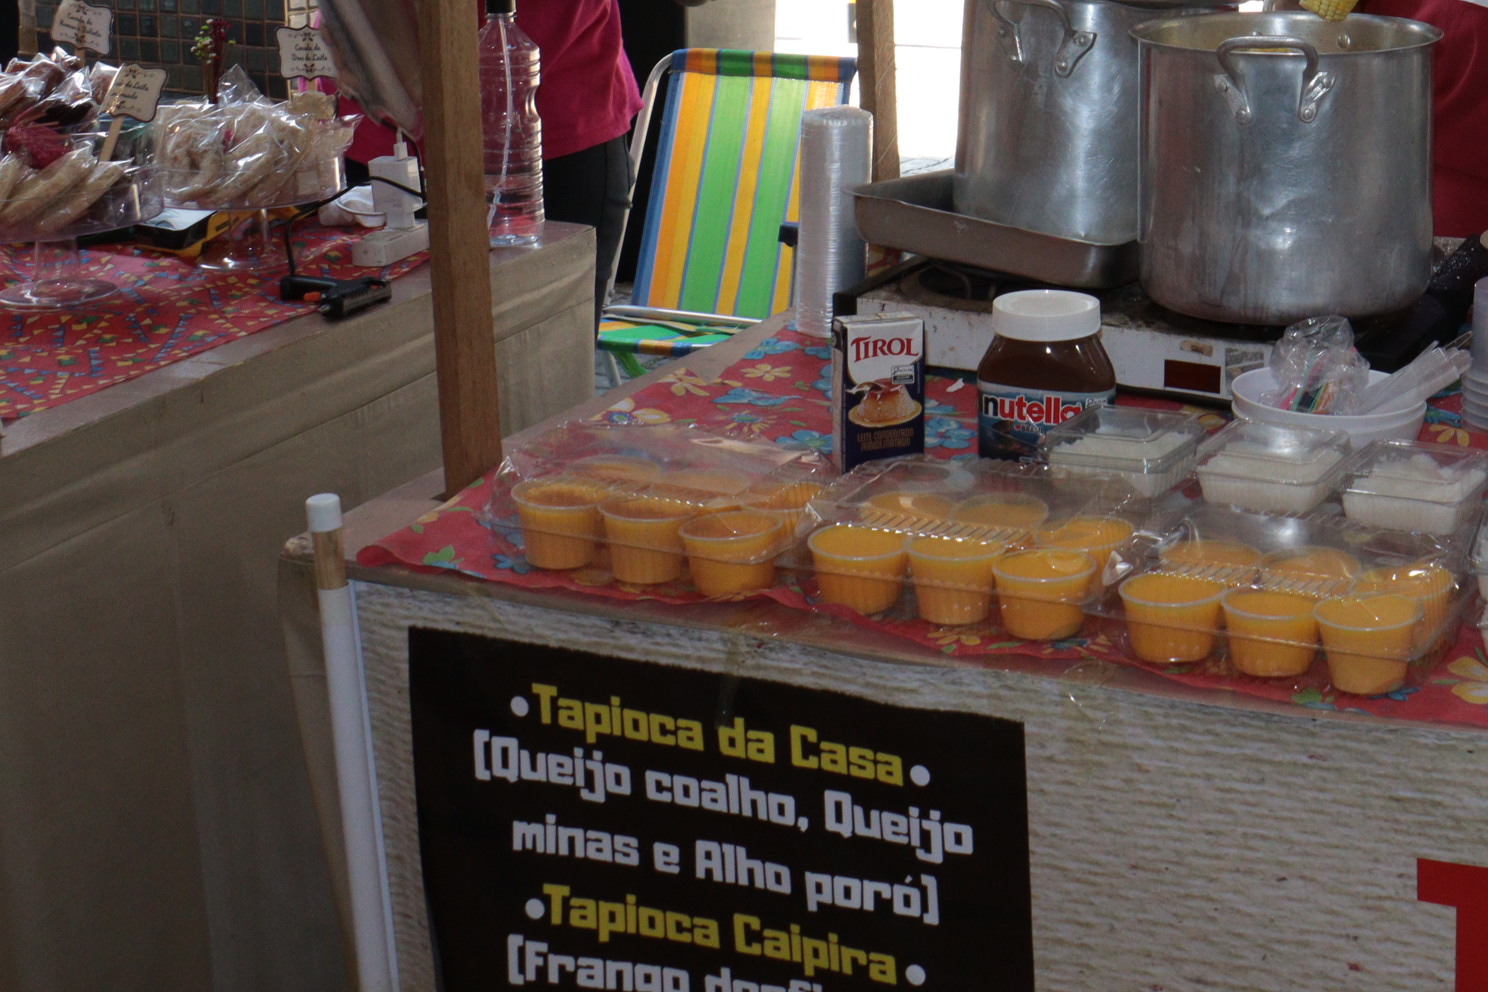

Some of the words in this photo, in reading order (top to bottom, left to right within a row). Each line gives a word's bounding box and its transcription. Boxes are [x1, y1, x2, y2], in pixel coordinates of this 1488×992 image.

[851, 336, 919, 363] TIROL
[983, 394, 1083, 426] nutella
[532, 682, 704, 752] Tapioca
[718, 717, 775, 765] da
[790, 724, 904, 787] Casa
[511, 813, 639, 867] minas
[653, 840, 680, 875] e
[695, 839, 791, 895] Alho
[645, 773, 810, 832] coalho,
[824, 789, 974, 864] Queijo
[542, 882, 721, 949] Tapioca
[733, 913, 898, 985] Caipira
